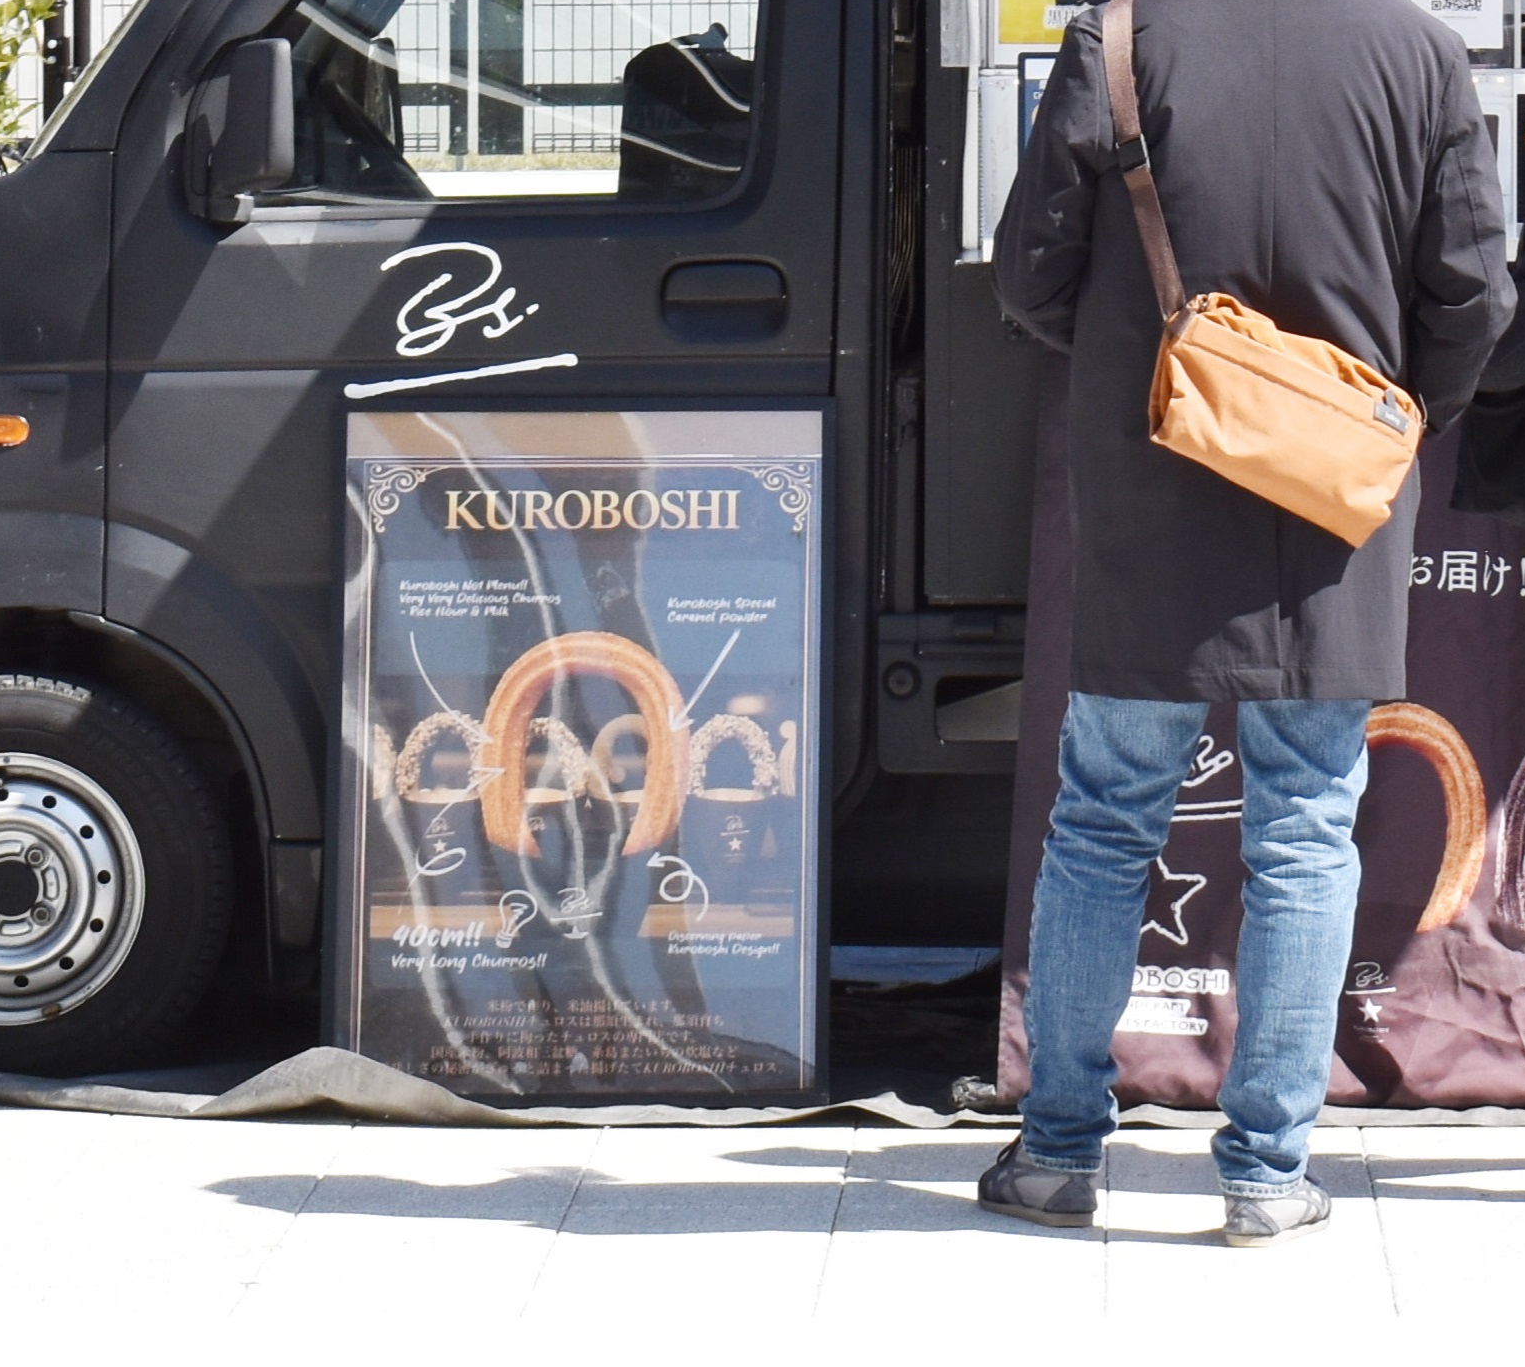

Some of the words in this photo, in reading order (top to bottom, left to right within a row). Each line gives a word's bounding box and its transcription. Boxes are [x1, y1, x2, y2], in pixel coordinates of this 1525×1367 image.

[445, 490, 740, 531] KUROBOSHI
[392, 923, 483, 947] 40cm!!
[667, 943, 727, 956] Kuroboshi
[391, 954, 426, 972] Very
[430, 954, 467, 974] Long
[471, 953, 548, 970] Churros!!
